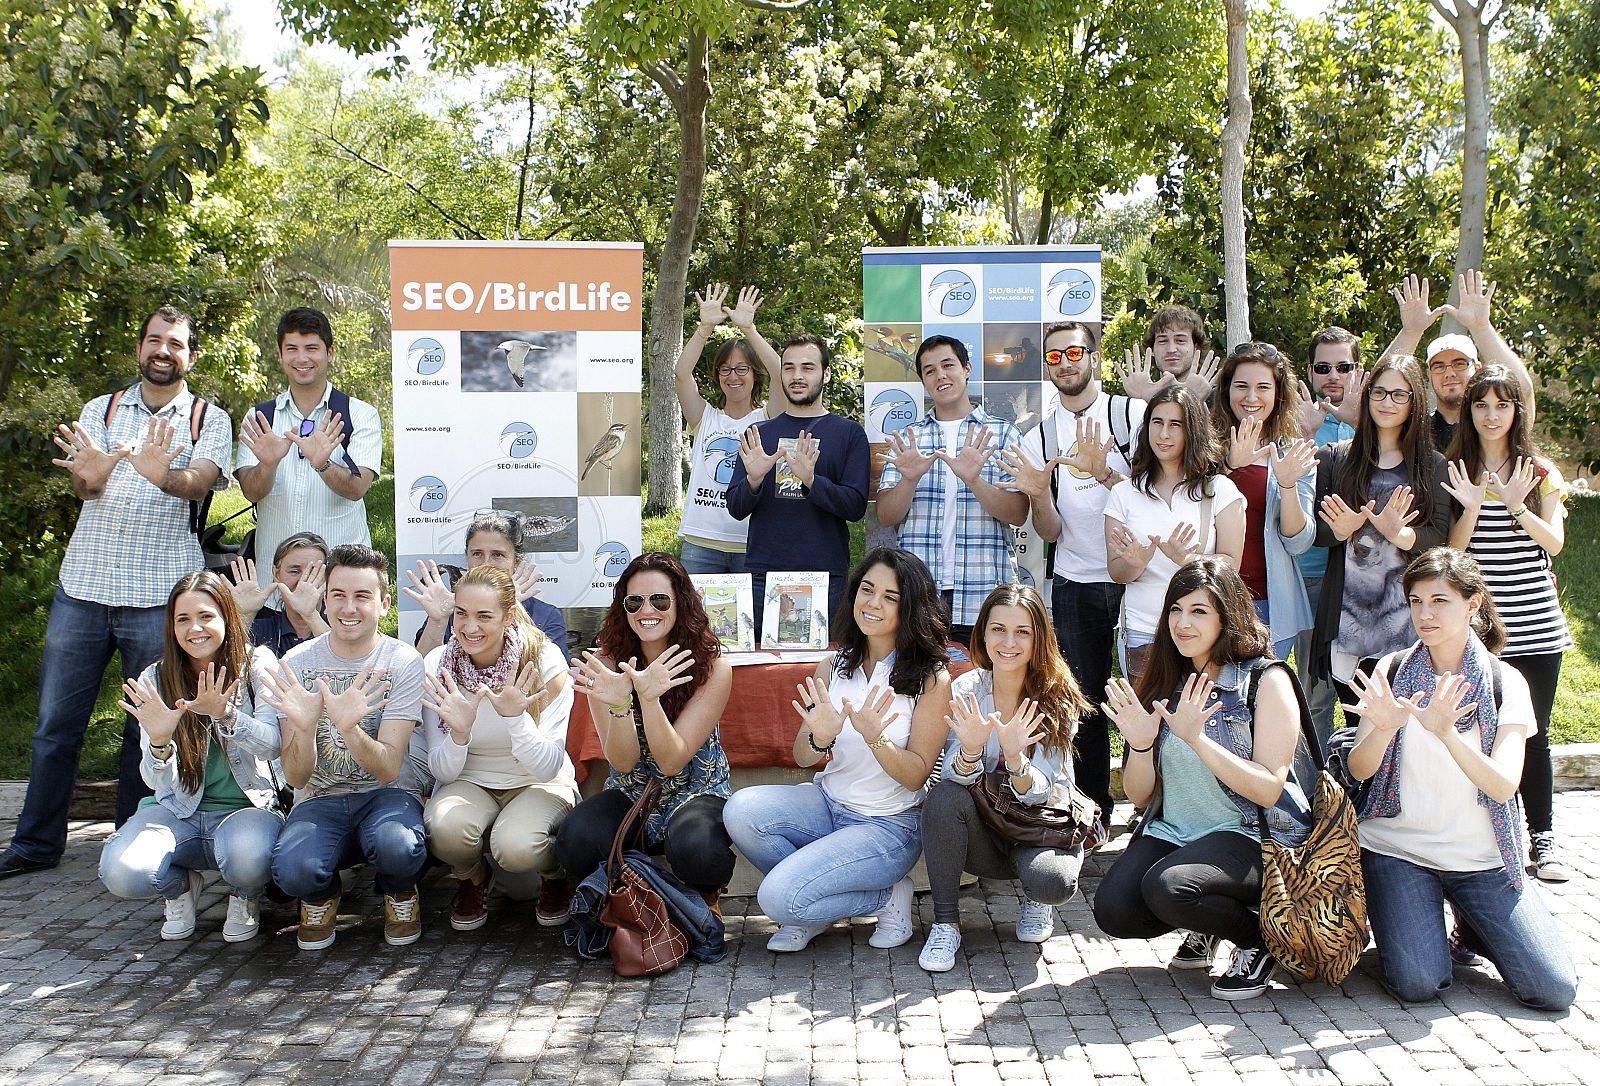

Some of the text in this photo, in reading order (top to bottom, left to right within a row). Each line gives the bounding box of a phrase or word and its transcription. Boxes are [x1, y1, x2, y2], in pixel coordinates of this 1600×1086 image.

[988, 287, 1034, 295] SEO/BirdLife
[1068, 290, 1091, 300] SEO
[402, 282, 632, 314] SEO/BirdLife
[949, 291, 972, 301] SEO
[424, 355, 441, 363] SEO
[590, 357, 634, 365] www.seo.org
[404, 379, 449, 387] SEO/BirdLife
[890, 410, 912, 420] SEO
[516, 438, 534, 446] SEO
[724, 459, 737, 469] SE
[778, 477, 803, 495] Pol
[1075, 482, 1099, 492] LONDO
[426, 492, 444, 500] SEO
[610, 557, 627, 565] SEO
